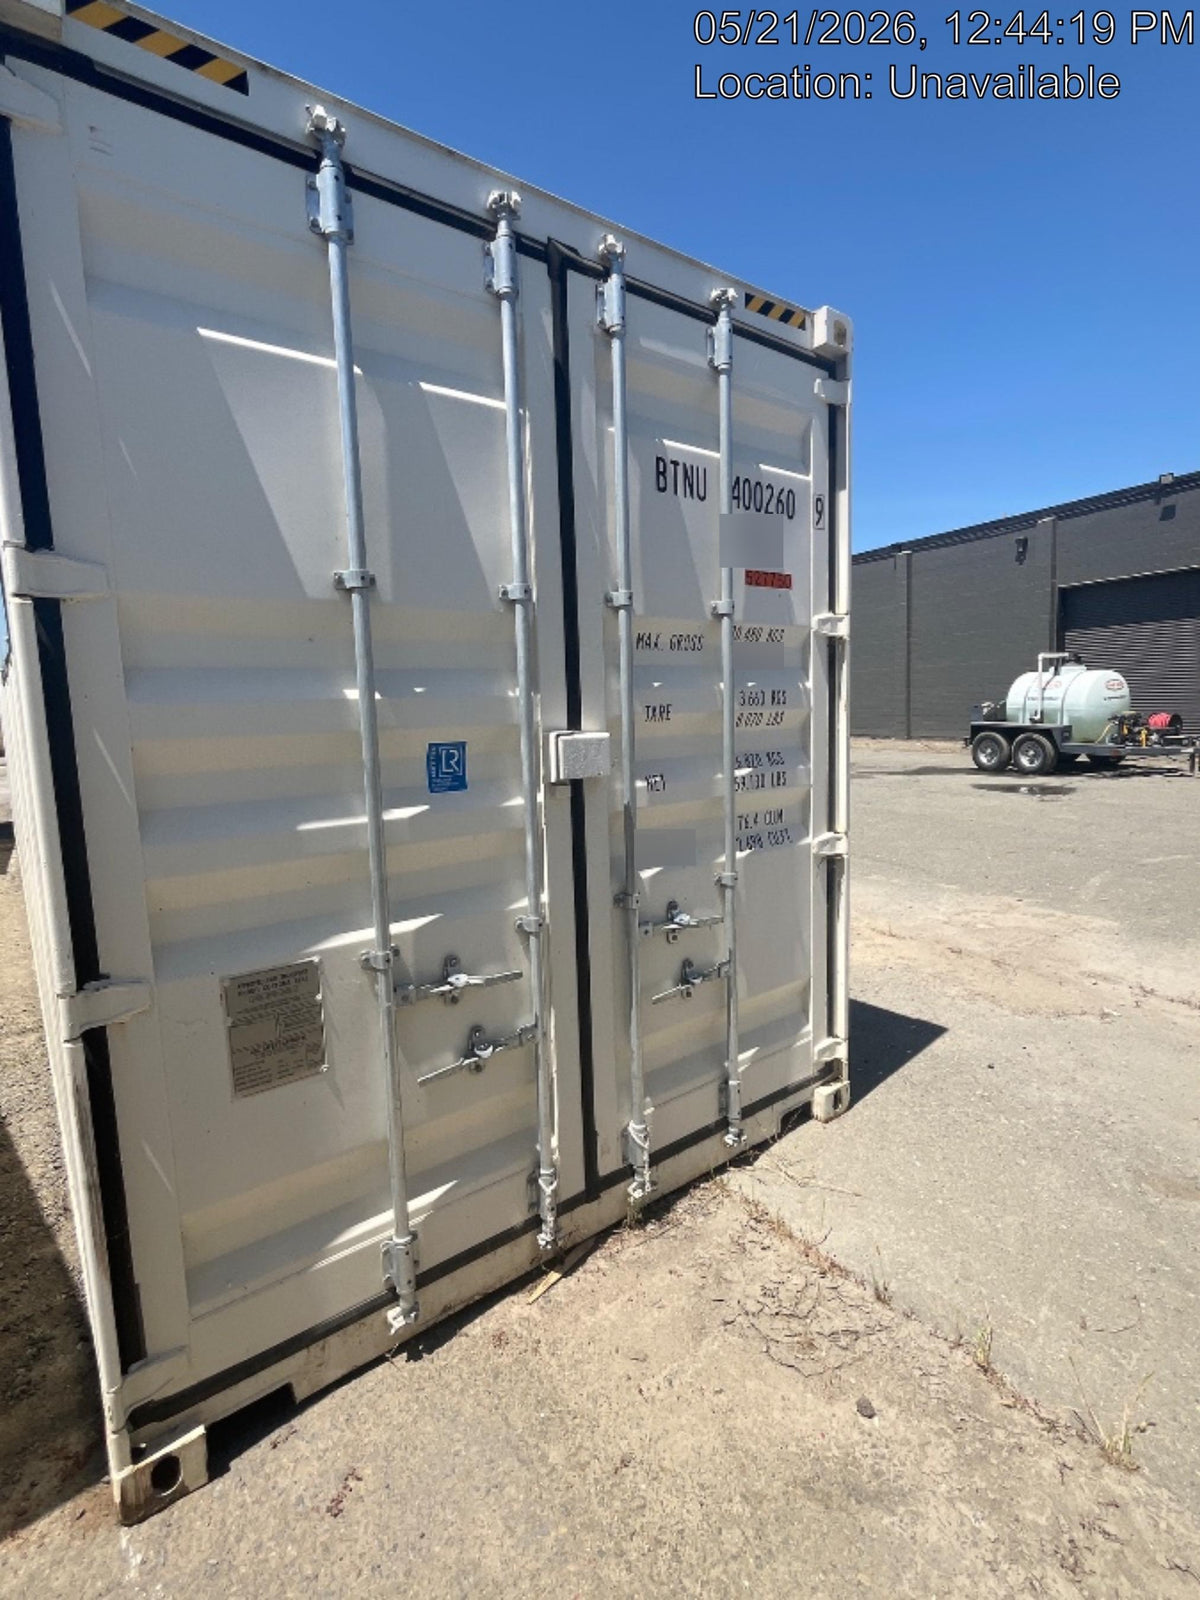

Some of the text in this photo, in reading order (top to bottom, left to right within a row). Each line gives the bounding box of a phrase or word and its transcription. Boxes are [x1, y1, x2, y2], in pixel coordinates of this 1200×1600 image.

[655, 456, 825, 527] BTNU 400260 9
[669, 633, 705, 651] GROSS
[645, 703, 672, 722] TARE
